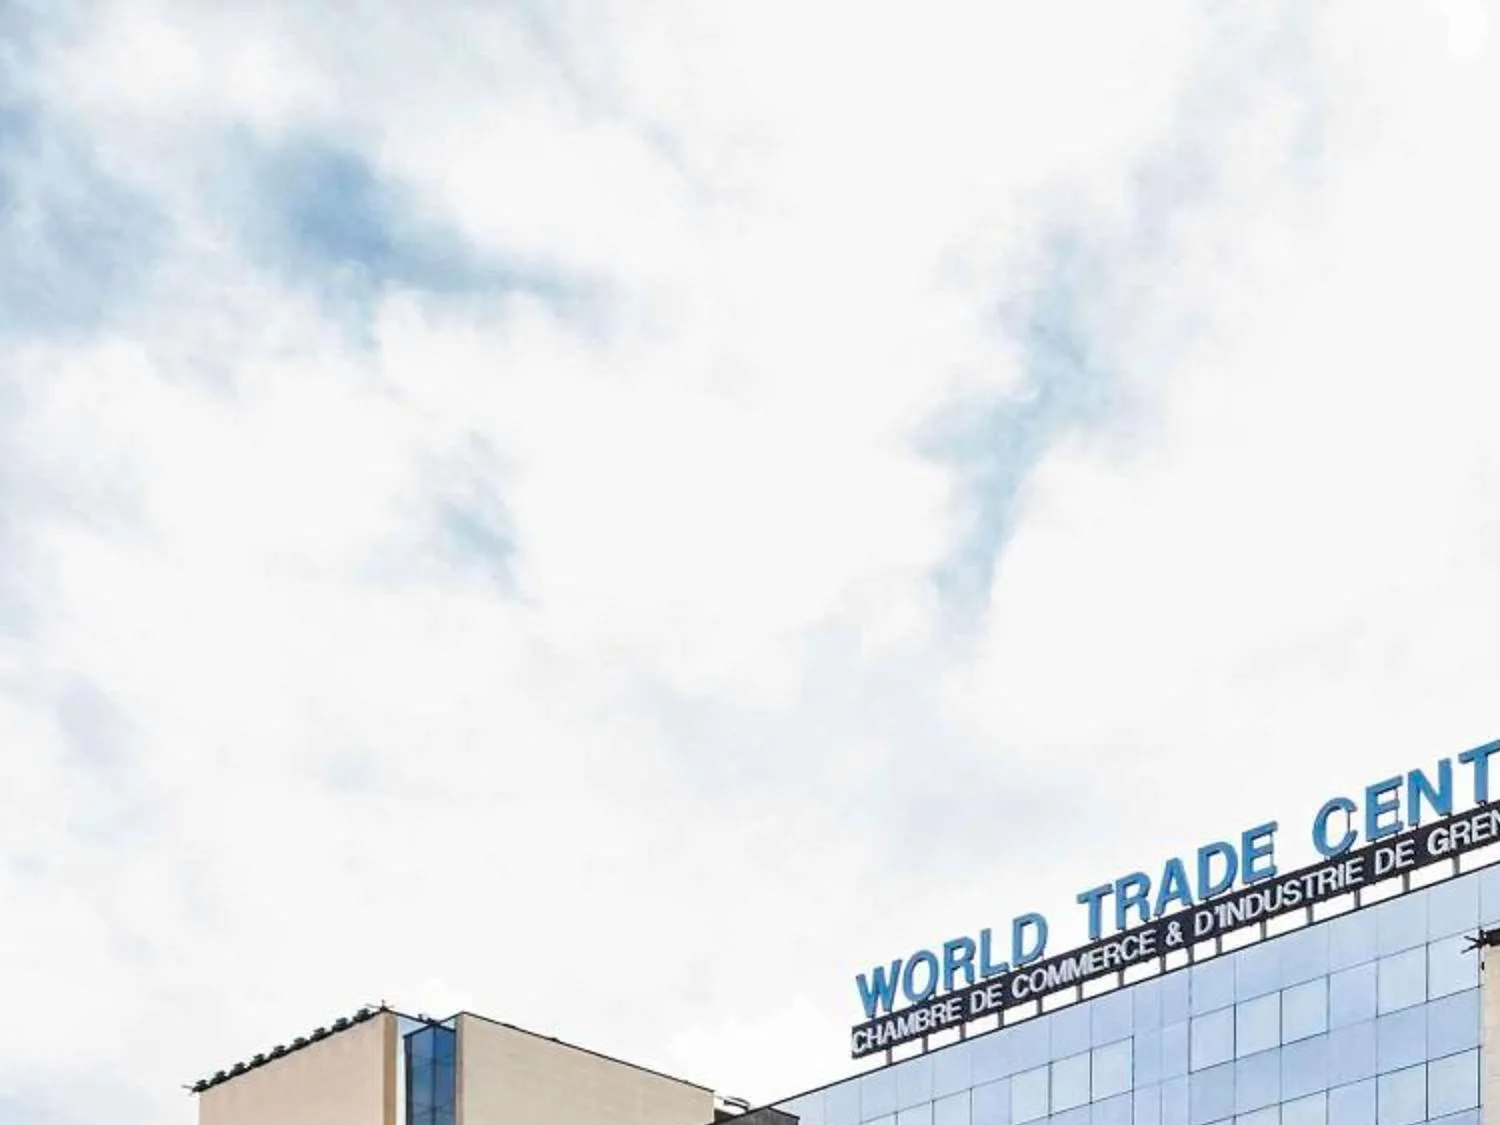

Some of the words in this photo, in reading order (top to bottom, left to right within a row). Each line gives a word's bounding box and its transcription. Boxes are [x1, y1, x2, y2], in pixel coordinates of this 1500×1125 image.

[852, 996, 962, 1053] CHAMBRE
[969, 983, 1004, 1014] DE
[1011, 928, 1157, 999] COMMERCE
[1165, 921, 1185, 946] &
[1194, 855, 1365, 936] D'INDUSTRIE
[1374, 838, 1415, 875] DE
[855, 912, 1049, 1018] WORLD
[1077, 820, 1279, 940] TRADE
